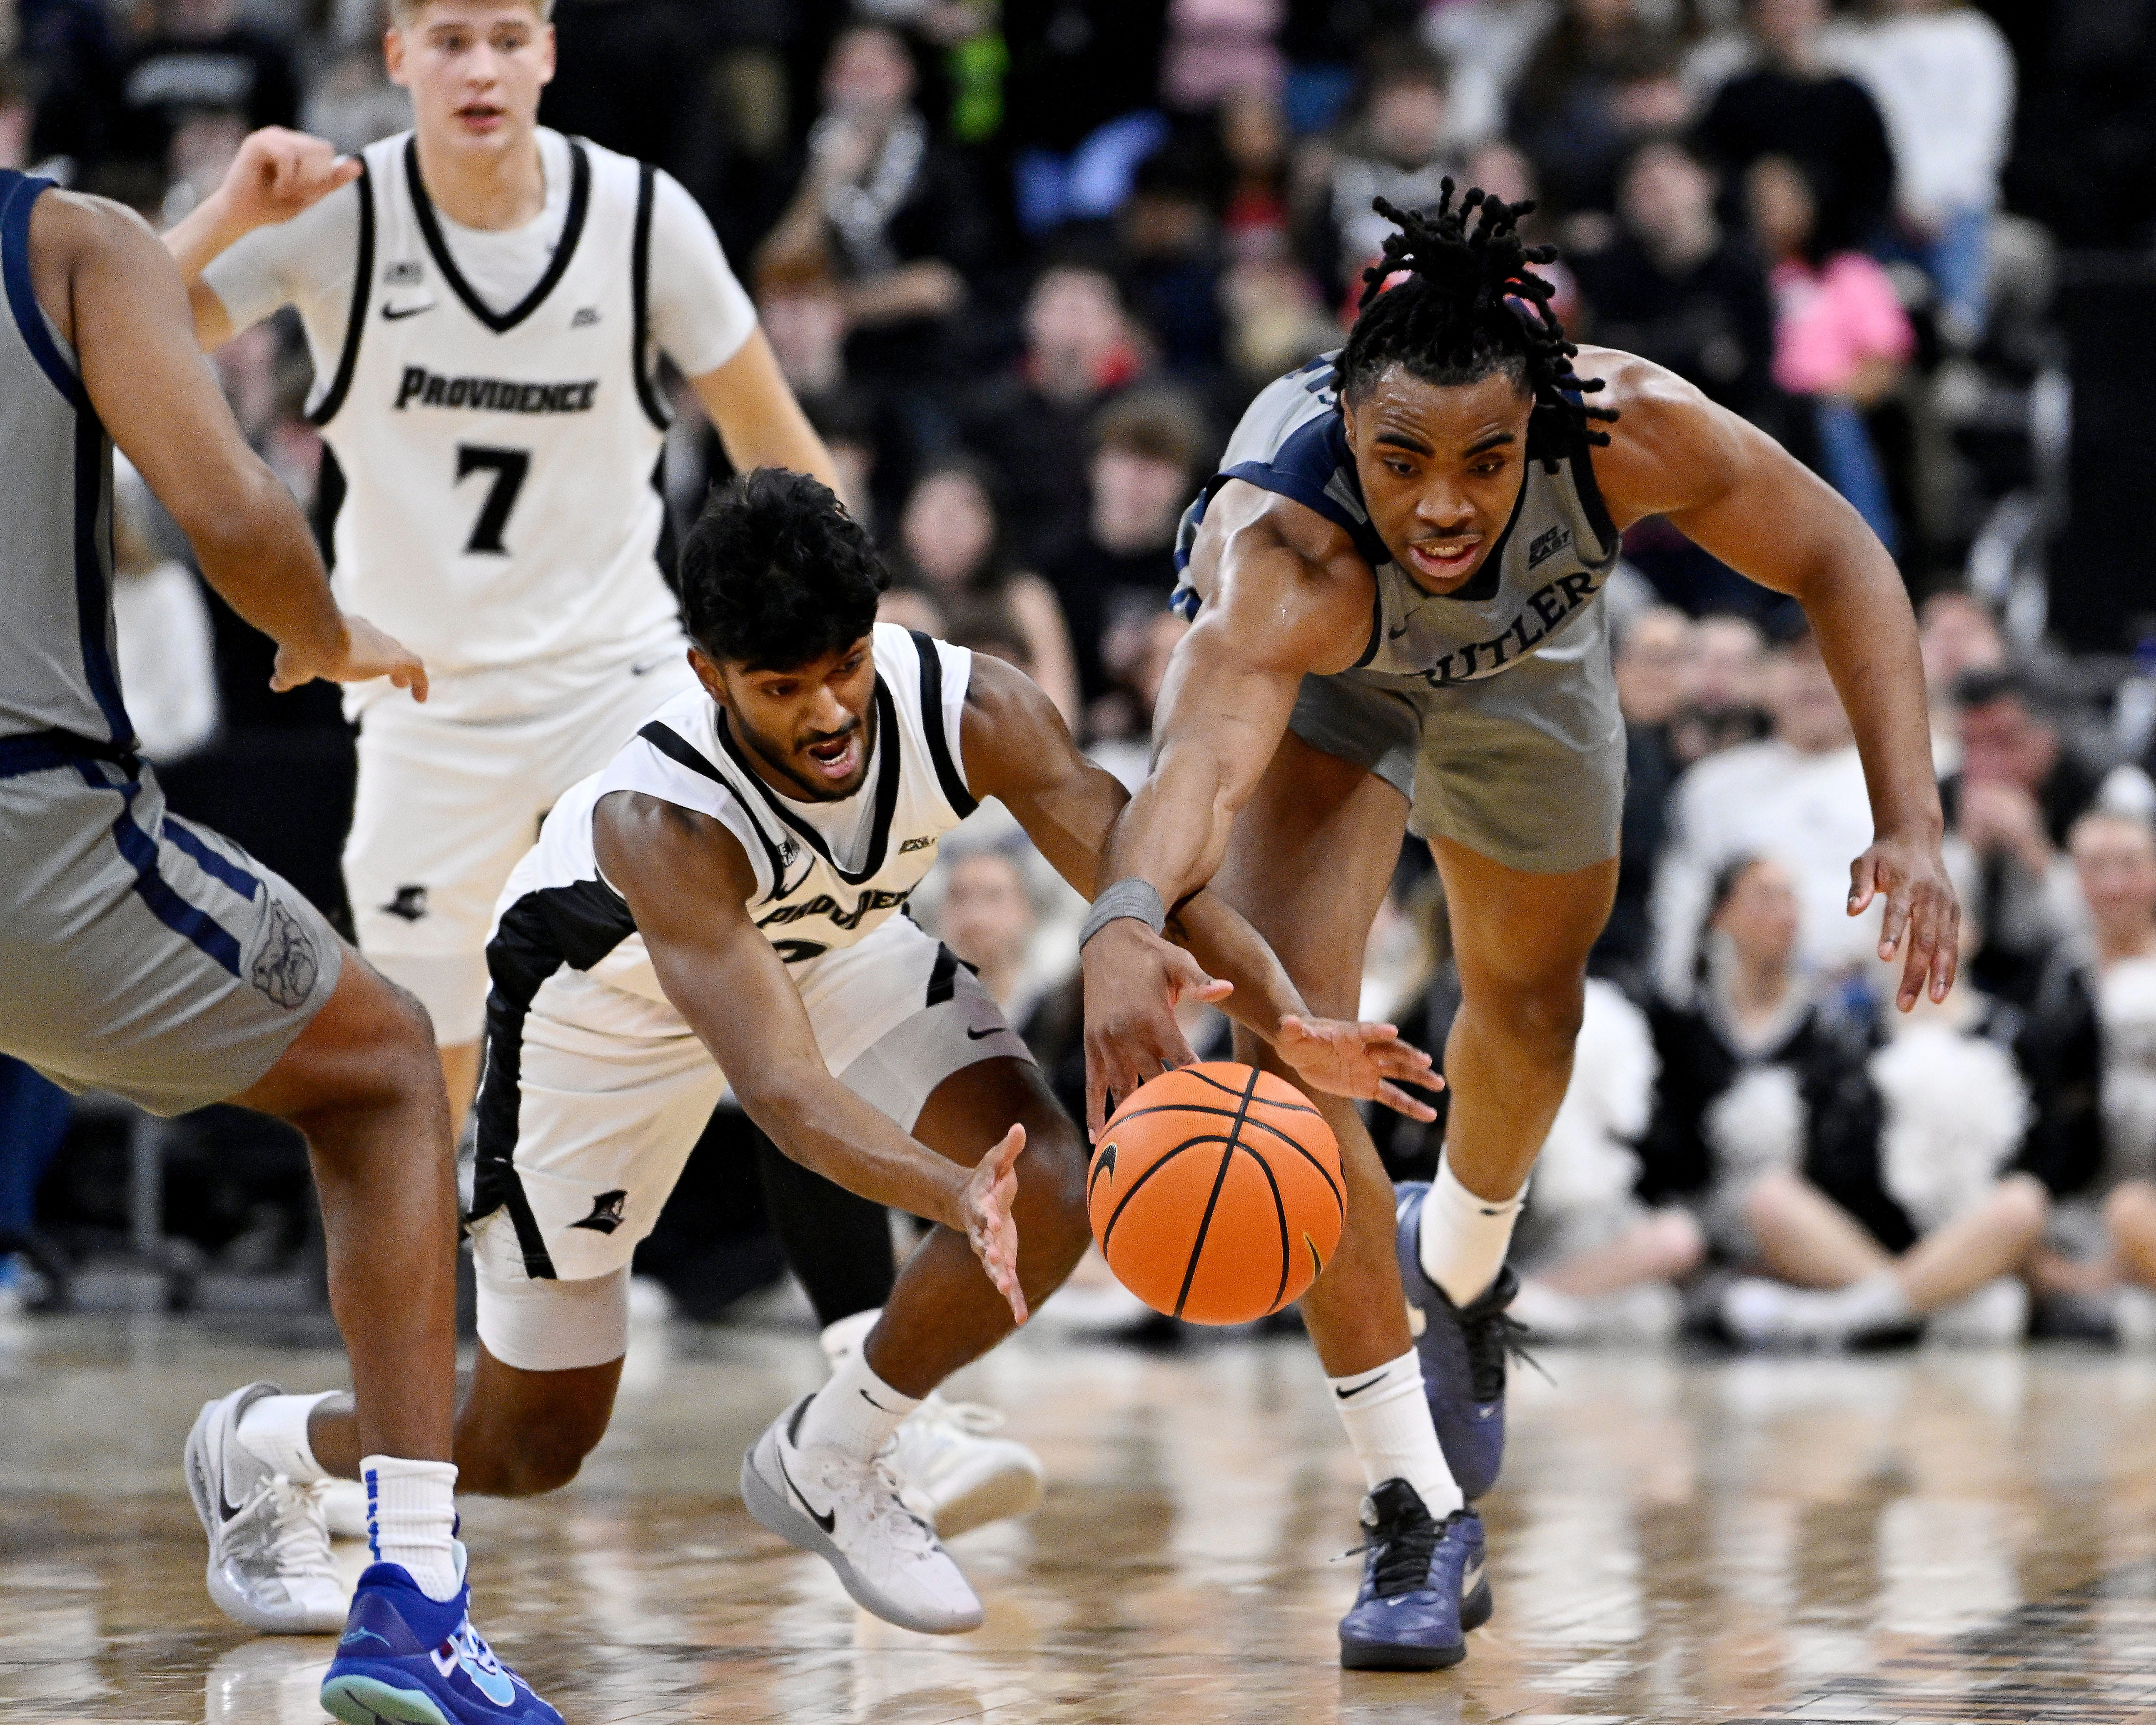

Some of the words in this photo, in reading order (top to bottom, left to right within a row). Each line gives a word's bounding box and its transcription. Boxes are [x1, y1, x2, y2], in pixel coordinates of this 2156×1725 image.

[394, 362, 598, 412] PROVIDENCE
[455, 442, 531, 556] 7
[1530, 526, 1558, 551] BIG
